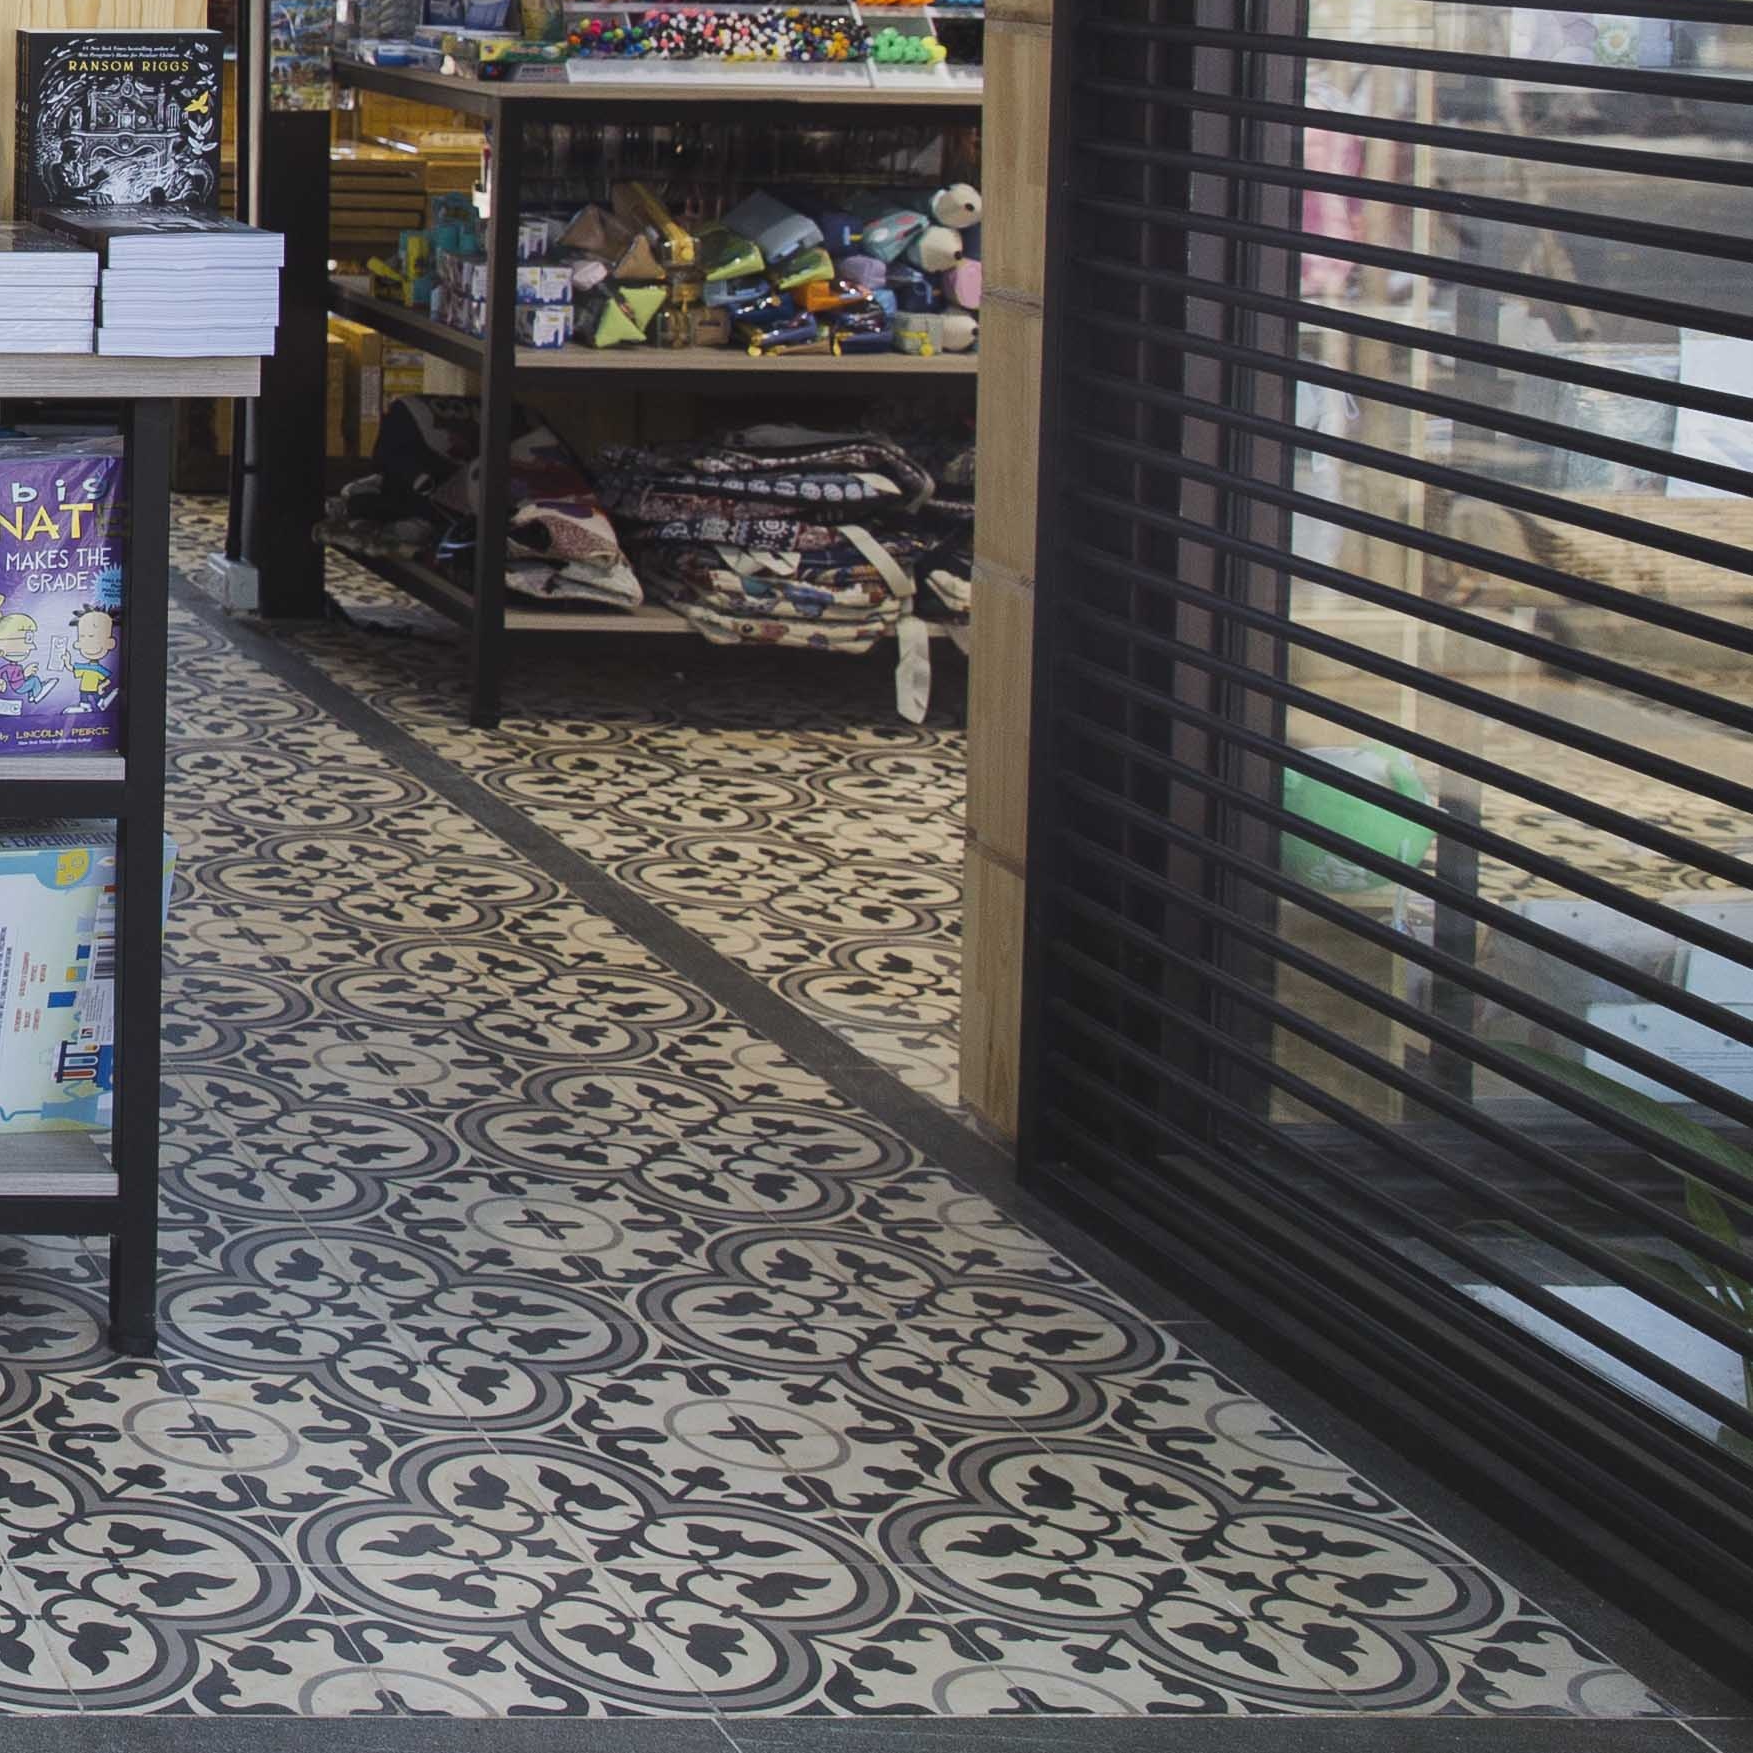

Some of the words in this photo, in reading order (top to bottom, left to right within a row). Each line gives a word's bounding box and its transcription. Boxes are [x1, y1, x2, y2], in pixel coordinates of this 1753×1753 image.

[68, 60, 134, 72] RANSOM
[142, 60, 190, 72] RIGGS
[12, 477, 108, 502] big
[6, 549, 69, 572] MAKES
[77, 547, 112, 567] THE
[27, 571, 88, 593] GRADE
[15, 729, 64, 740] LINCOLN
[71, 727, 110, 737] PEIRCE
